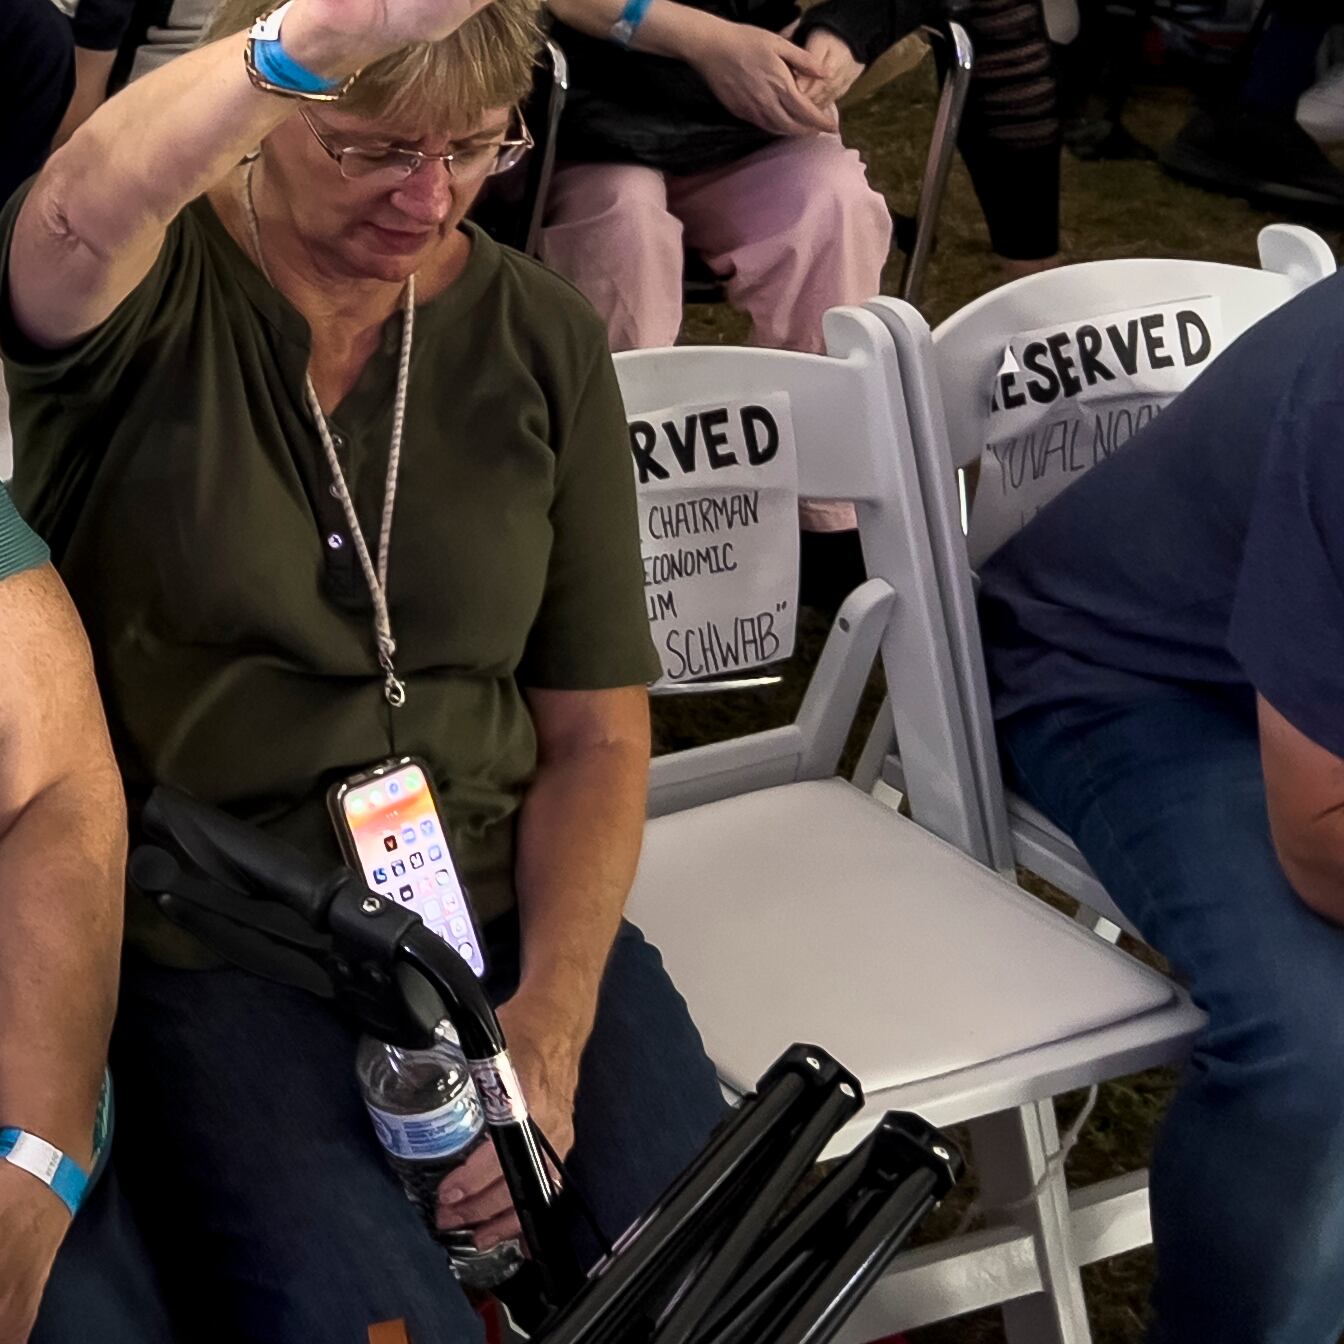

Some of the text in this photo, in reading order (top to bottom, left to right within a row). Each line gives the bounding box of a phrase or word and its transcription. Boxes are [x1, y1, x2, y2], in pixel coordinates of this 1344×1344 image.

[991, 309, 1213, 413] ESERVED
[628, 404, 780, 485] RVED
[1092, 403, 1163, 466] NO
[647, 489, 760, 541] CHAIRMAN
